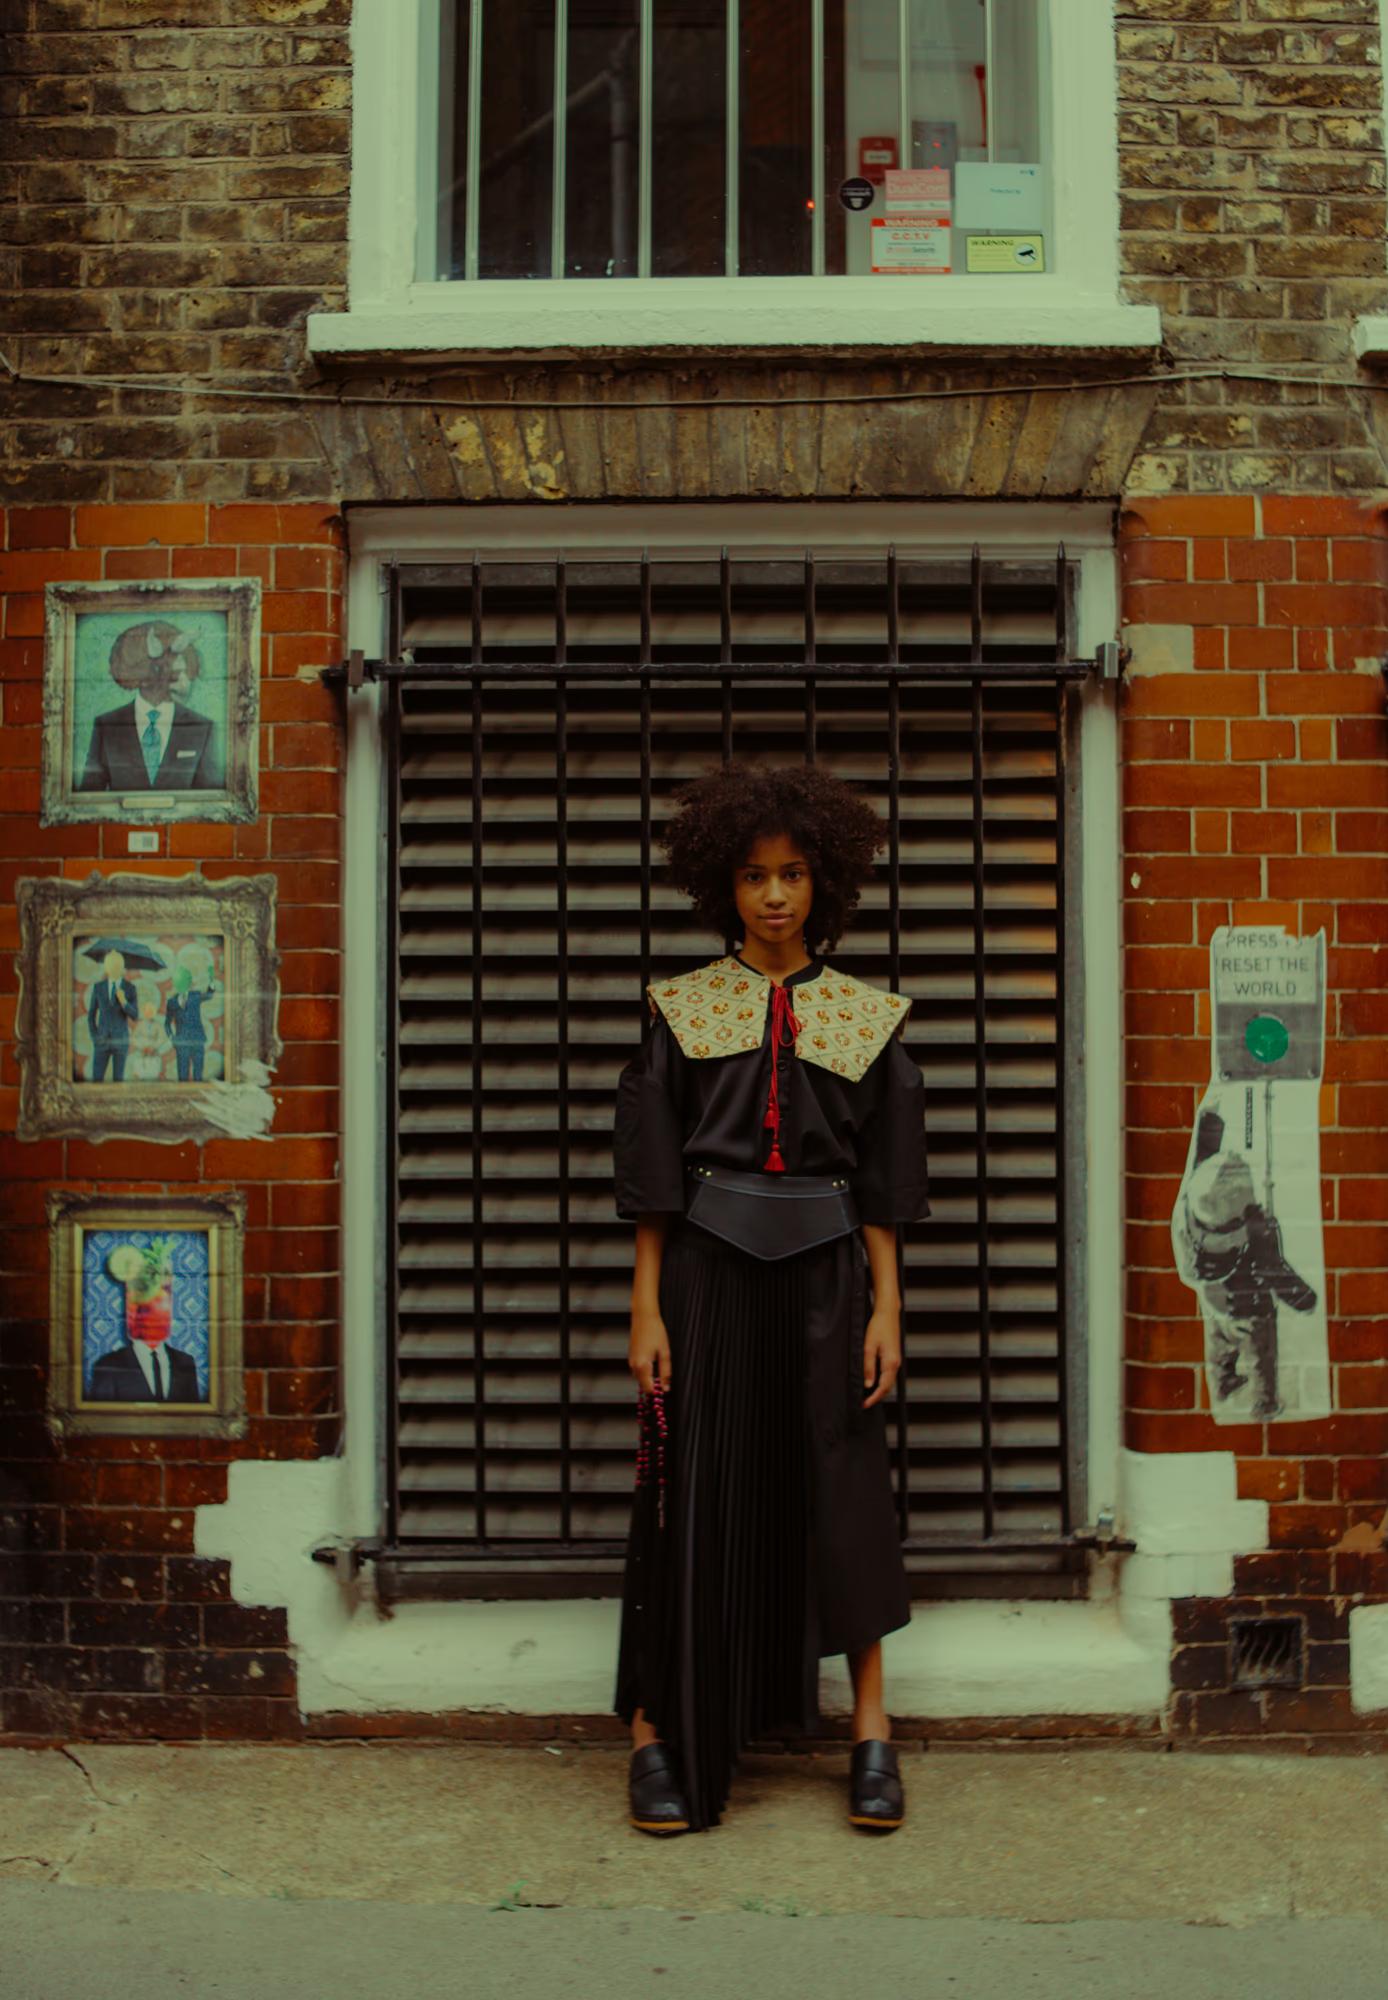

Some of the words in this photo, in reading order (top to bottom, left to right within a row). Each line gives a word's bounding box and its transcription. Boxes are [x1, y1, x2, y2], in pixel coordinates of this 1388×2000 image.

[885, 218, 938, 227] WARNING
[1226, 934, 1279, 949] PRESS
[1221, 957, 1272, 972] RESET
[1278, 957, 1309, 972] THE
[1235, 981, 1296, 997] WORLD
